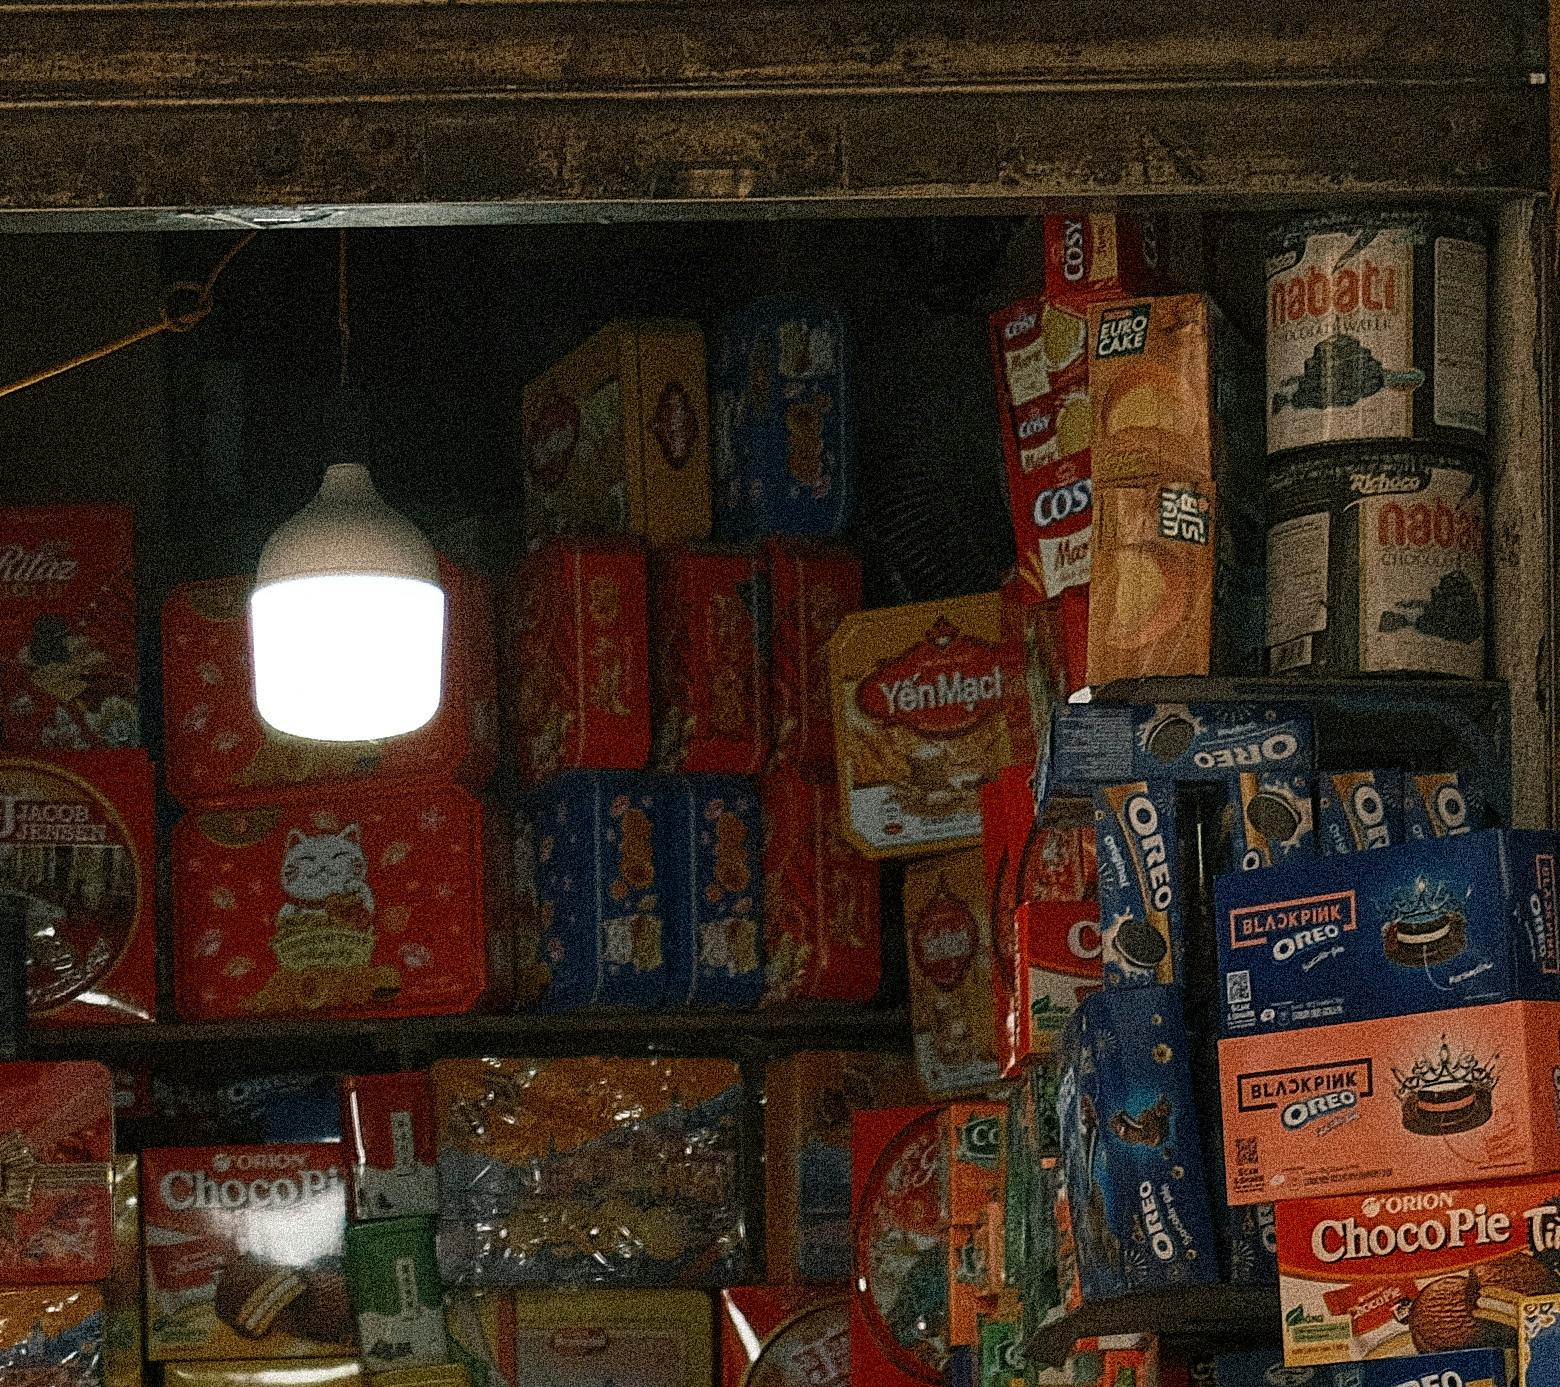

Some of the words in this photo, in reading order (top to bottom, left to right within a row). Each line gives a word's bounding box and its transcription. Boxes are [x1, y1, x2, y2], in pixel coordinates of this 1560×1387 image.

[1064, 220, 1085, 281] COSY
[1192, 731, 1299, 769] OREO
[16, 823, 107, 842] JENSEN
[17, 802, 90, 823] JACOB
[1129, 796, 1172, 912] OREO
[1272, 922, 1341, 962] OREO
[1281, 1089, 1358, 1131] OREO
[160, 1168, 344, 1211] ChocoPi
[1386, 1192, 1454, 1215] ORION
[1139, 1181, 1172, 1262] OREO
